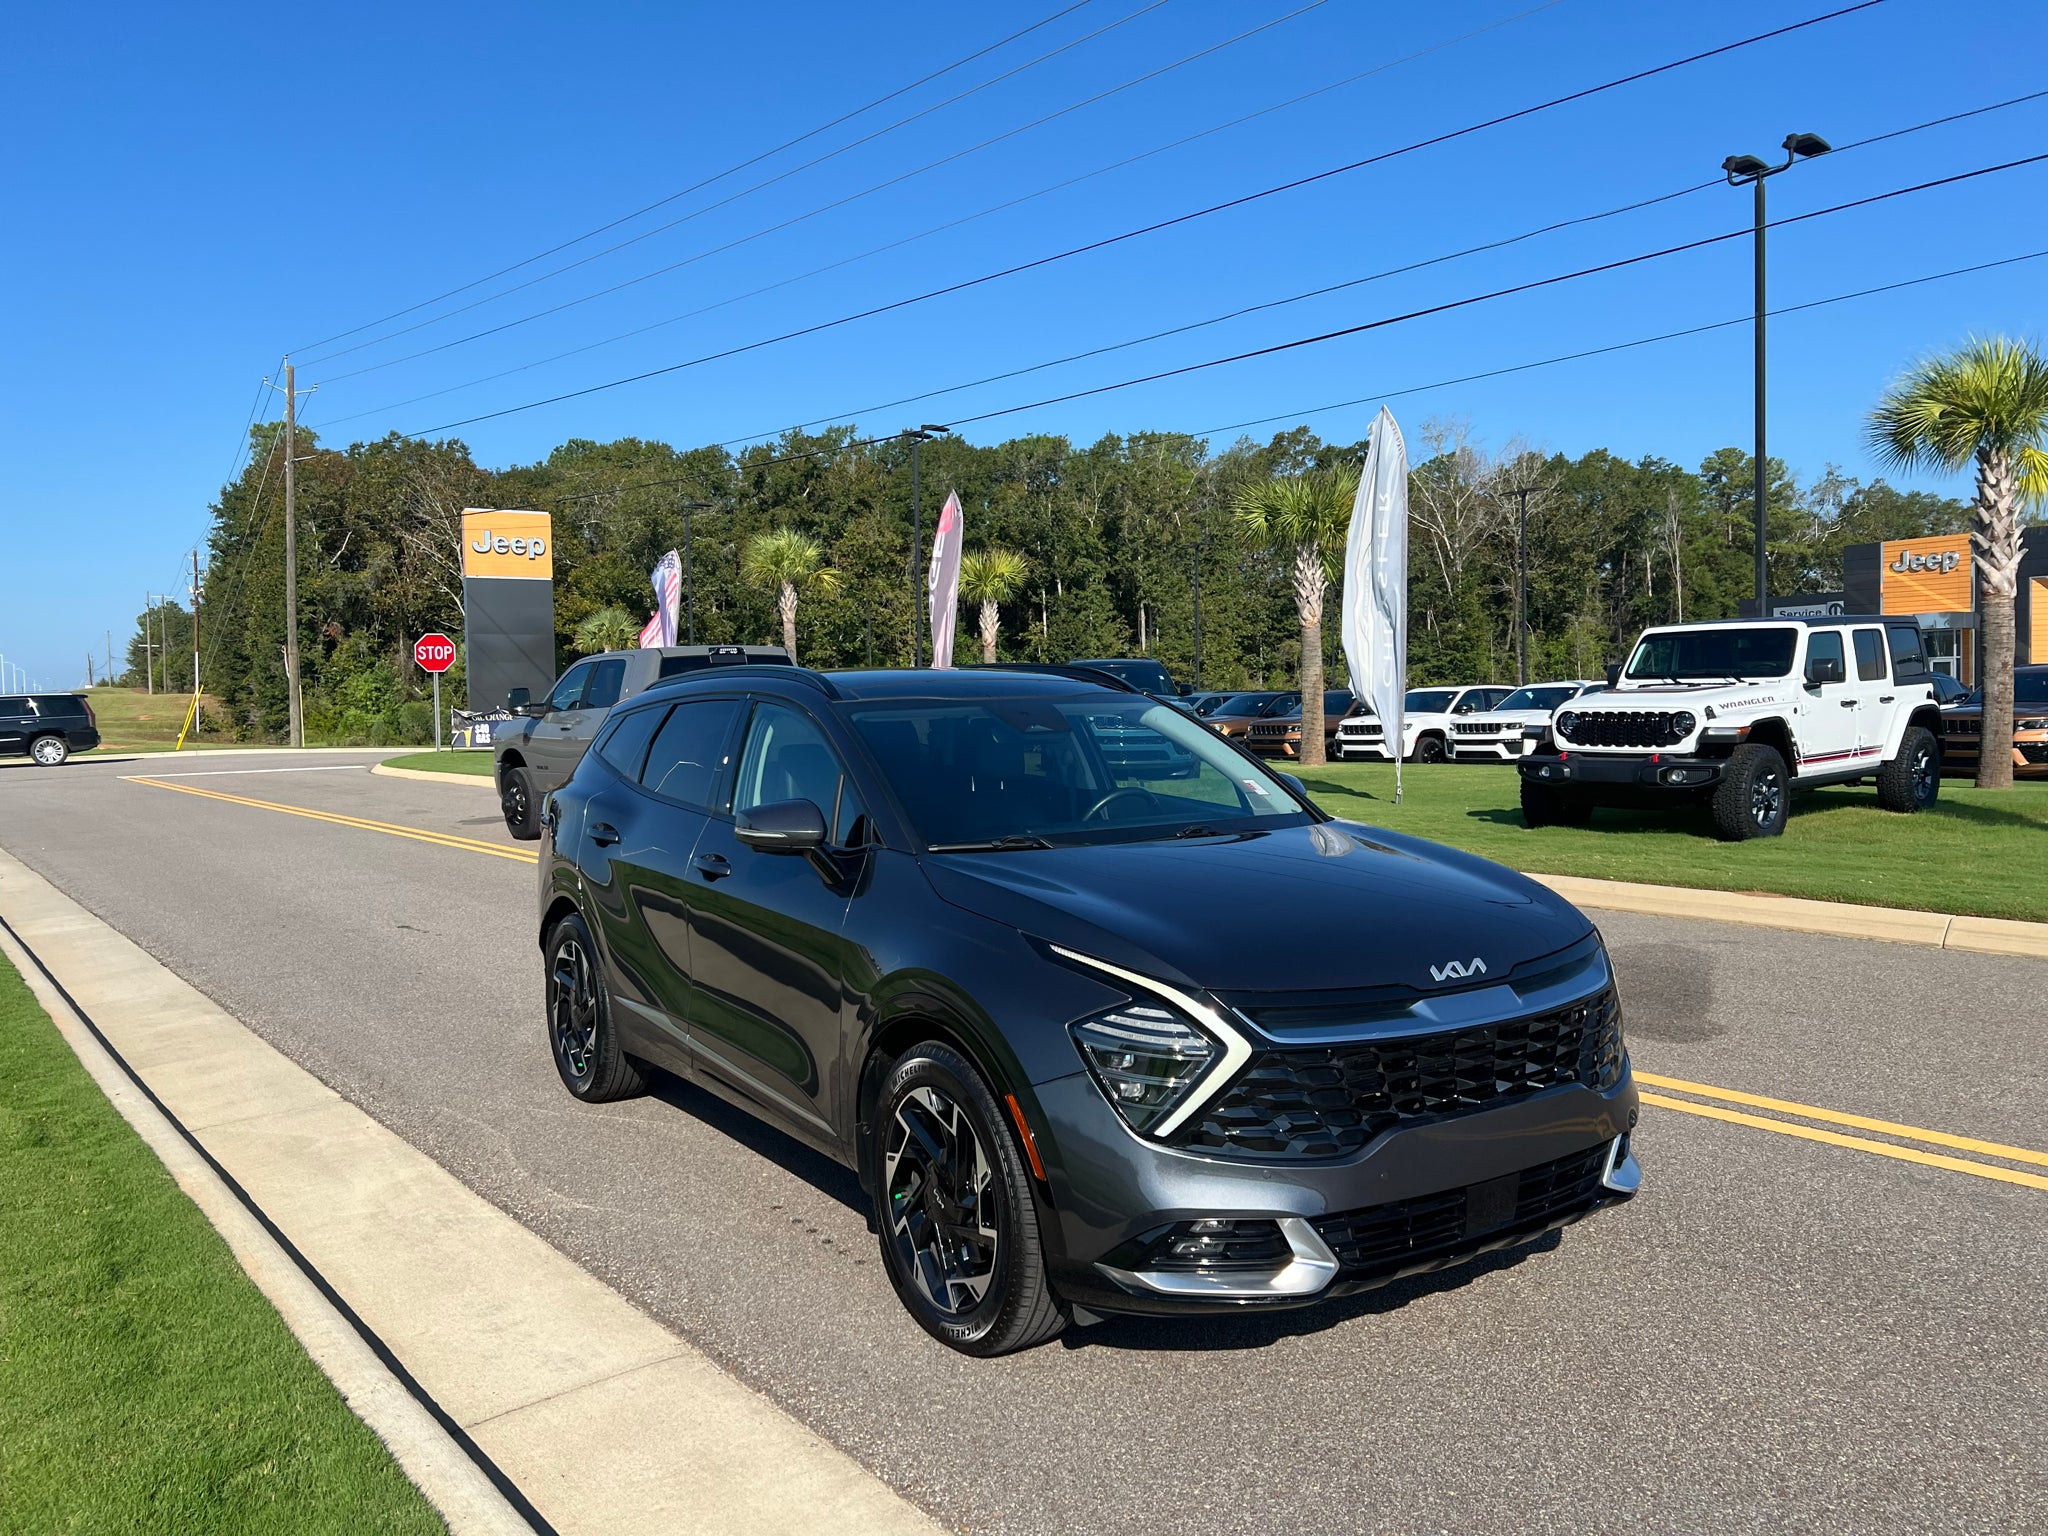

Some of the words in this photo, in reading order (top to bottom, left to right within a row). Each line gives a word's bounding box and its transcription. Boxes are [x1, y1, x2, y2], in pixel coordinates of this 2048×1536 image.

[471, 529, 546, 561] Jeep
[1890, 549, 1960, 573] Jeep
[1779, 608, 1823, 618] Service
[417, 645, 453, 661] STOP
[1718, 695, 1775, 710] WRANGLER
[485, 713, 514, 721] CHANGE
[1429, 957, 1488, 982] KIA
